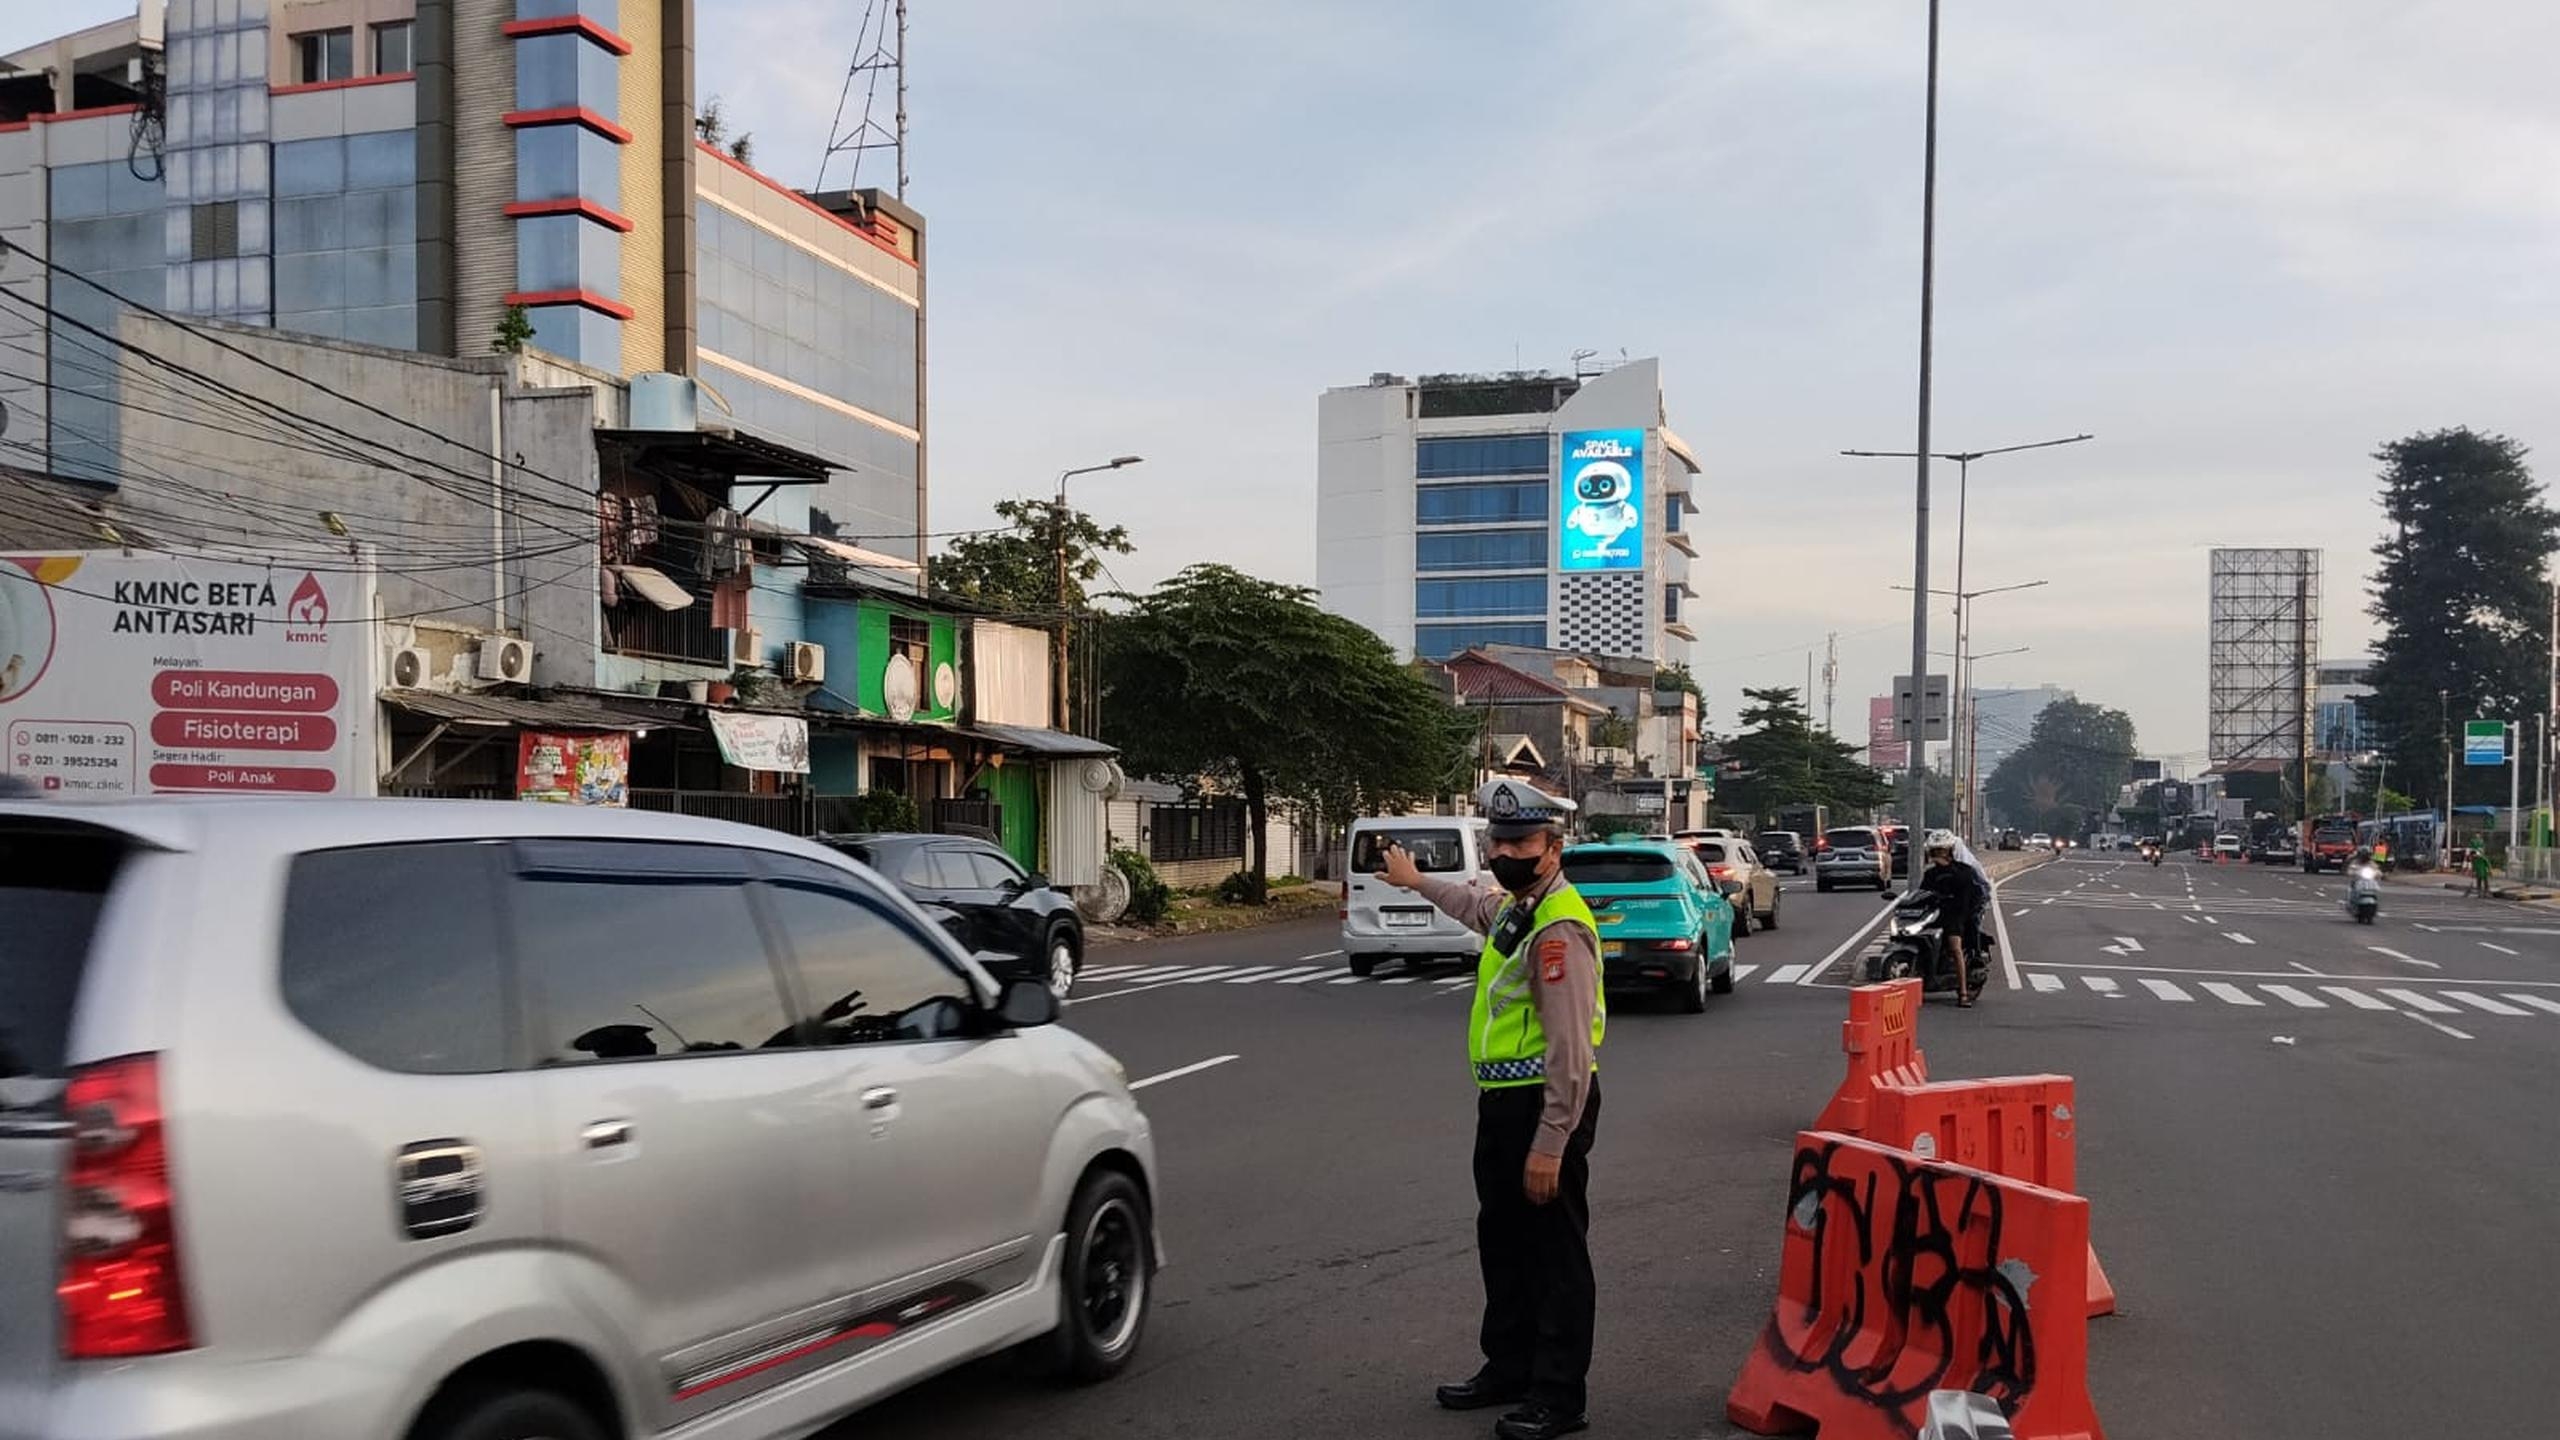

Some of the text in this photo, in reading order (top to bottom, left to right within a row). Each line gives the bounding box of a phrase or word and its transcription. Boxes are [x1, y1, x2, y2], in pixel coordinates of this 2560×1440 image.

[1585, 440, 1619, 450] SPACE
[1572, 447, 1633, 459] AVAILABLE
[114, 581, 277, 607] KMNC BETA
[113, 611, 254, 635] ANTASARI
[286, 630, 328, 643] kmnc
[170, 680, 316, 704] Poli Kandungan
[184, 719, 299, 745] Fisioterapi
[104, 735, 125, 745] 232
[34, 755, 54, 766] 021
[153, 750, 187, 763] Segera
[208, 770, 276, 784] Poli Anak
